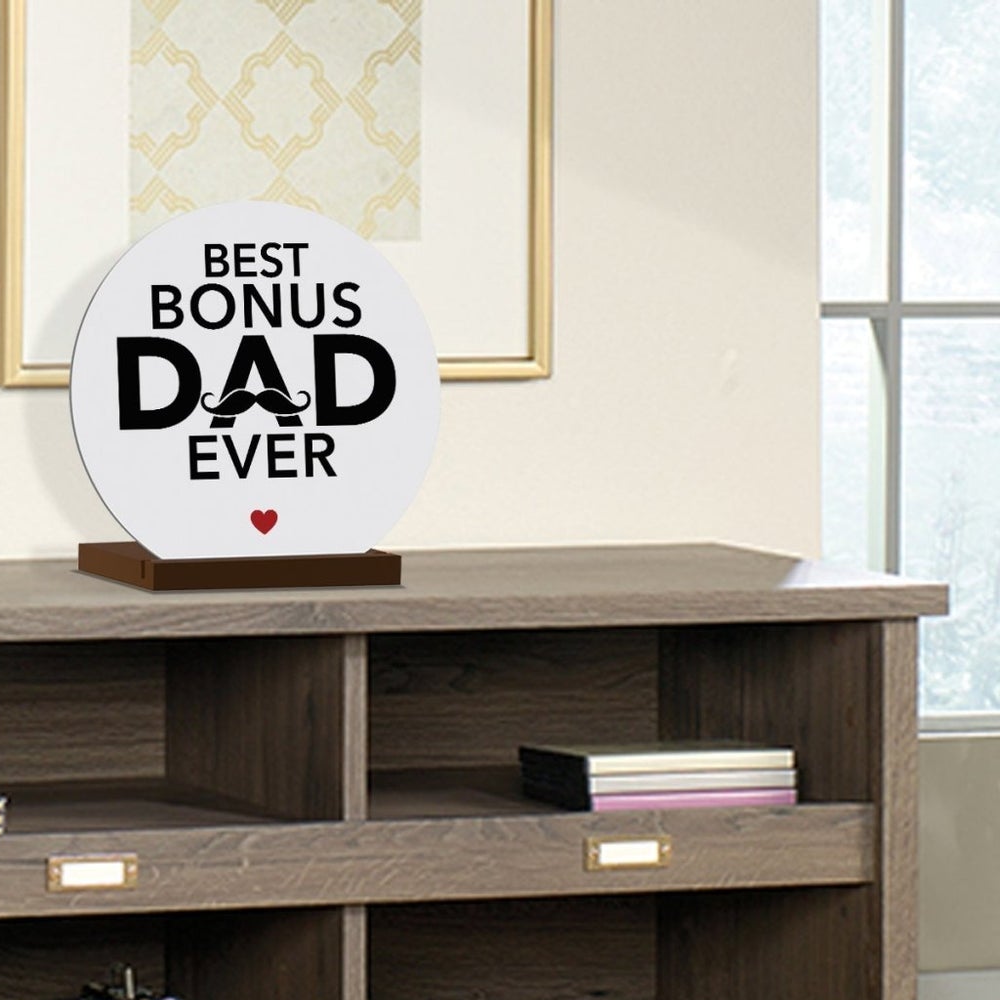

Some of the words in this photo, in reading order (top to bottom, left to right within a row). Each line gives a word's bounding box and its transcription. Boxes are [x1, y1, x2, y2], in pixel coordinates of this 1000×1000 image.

[204, 242, 309, 278] BEST
[151, 282, 362, 330] BONUS
[116, 333, 397, 431] DAD
[188, 432, 338, 480] EVER
